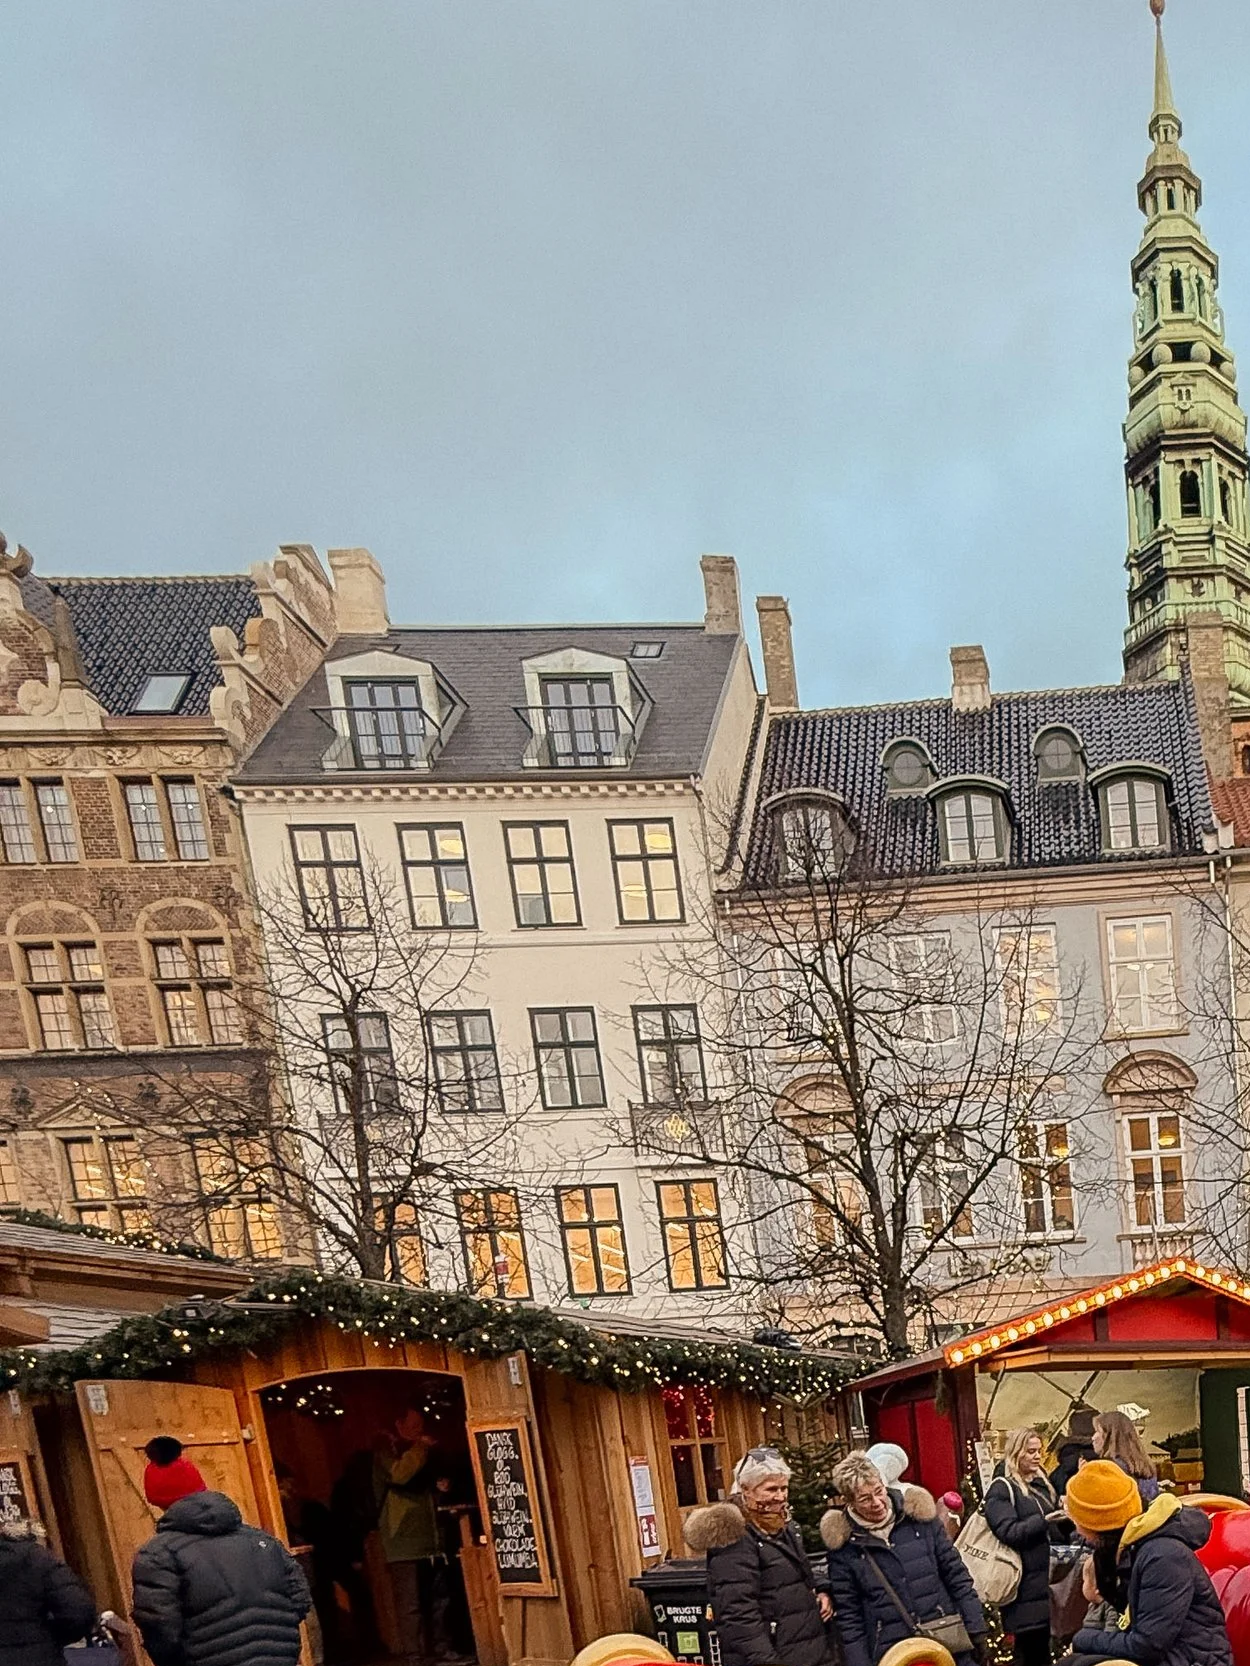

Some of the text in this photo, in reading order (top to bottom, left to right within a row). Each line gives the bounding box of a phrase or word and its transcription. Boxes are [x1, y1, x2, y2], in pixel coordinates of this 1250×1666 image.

[485, 1432, 514, 1448] DANSK
[666, 1606, 703, 1616] BRUGTE
[672, 1615, 698, 1624] KRUS
